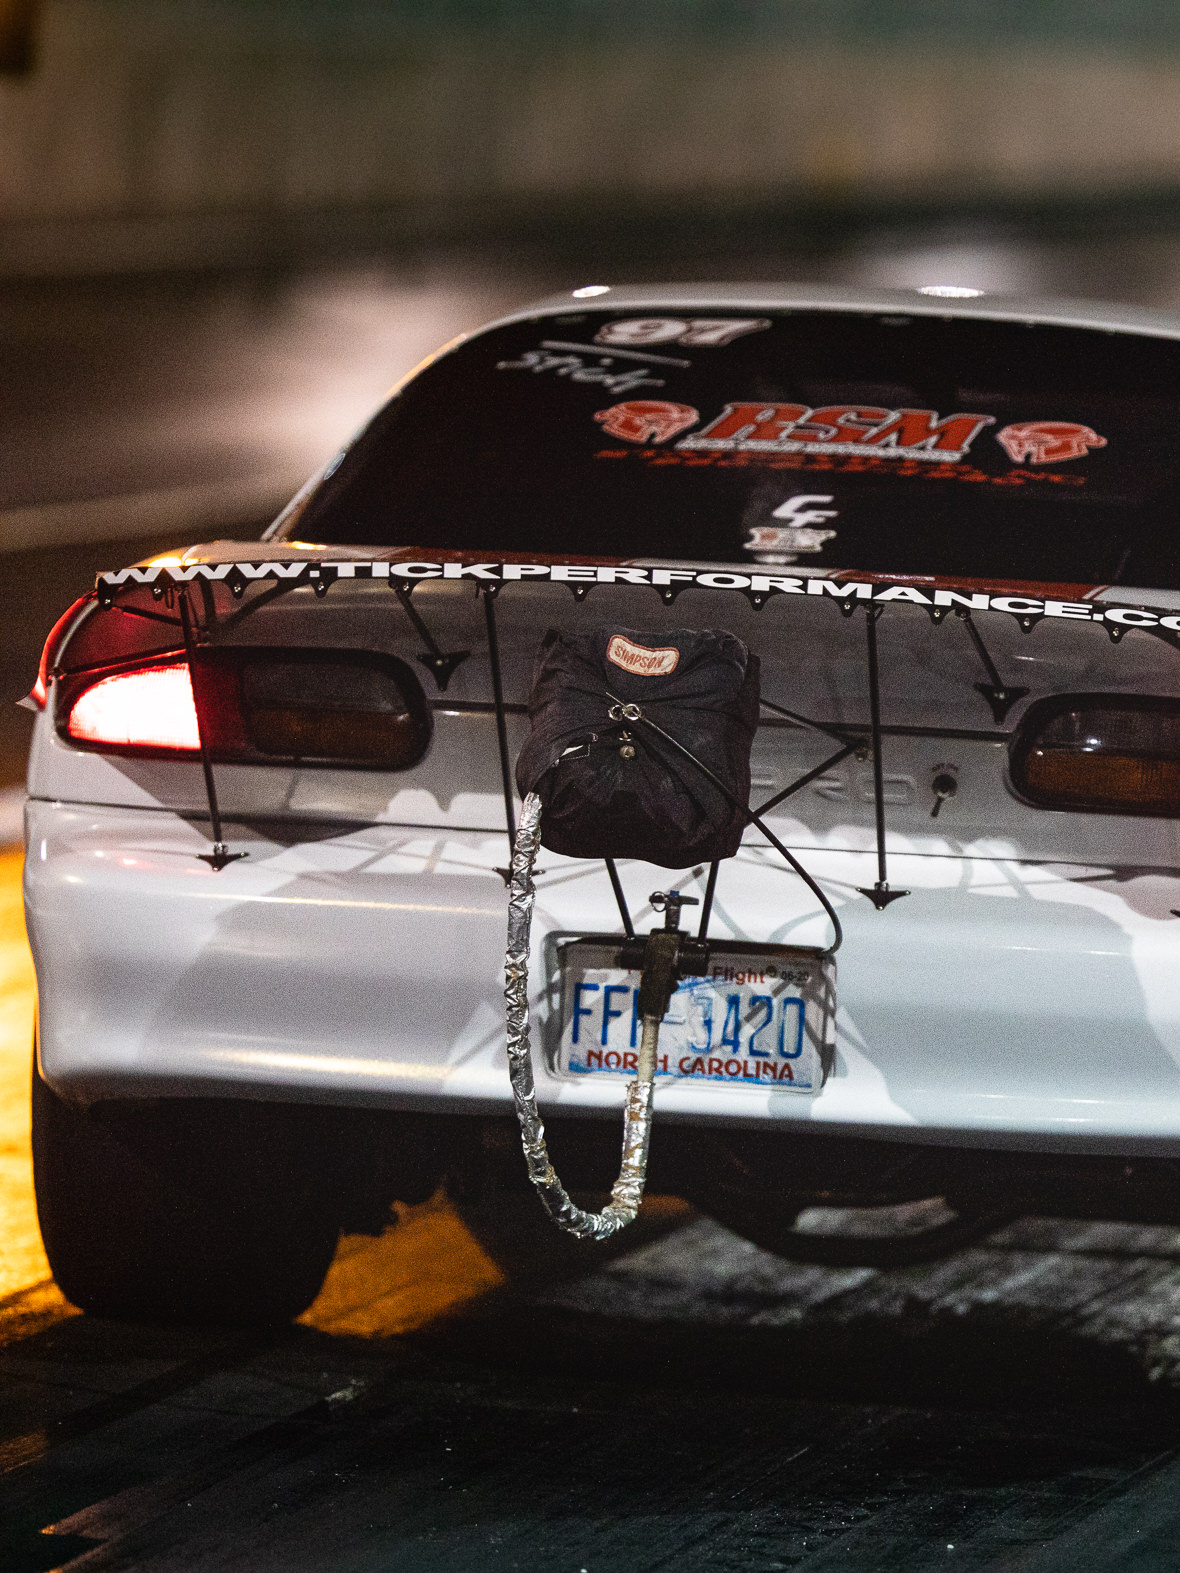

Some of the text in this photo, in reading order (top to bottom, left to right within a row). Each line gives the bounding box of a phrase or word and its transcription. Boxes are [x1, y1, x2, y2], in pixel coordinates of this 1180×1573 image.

[594, 317, 773, 347] 97
[680, 402, 996, 458] RSM
[614, 645, 665, 669] SIMPSON
[712, 966, 765, 985] Flight
[587, 1050, 794, 1081] NORH CAROLINA
